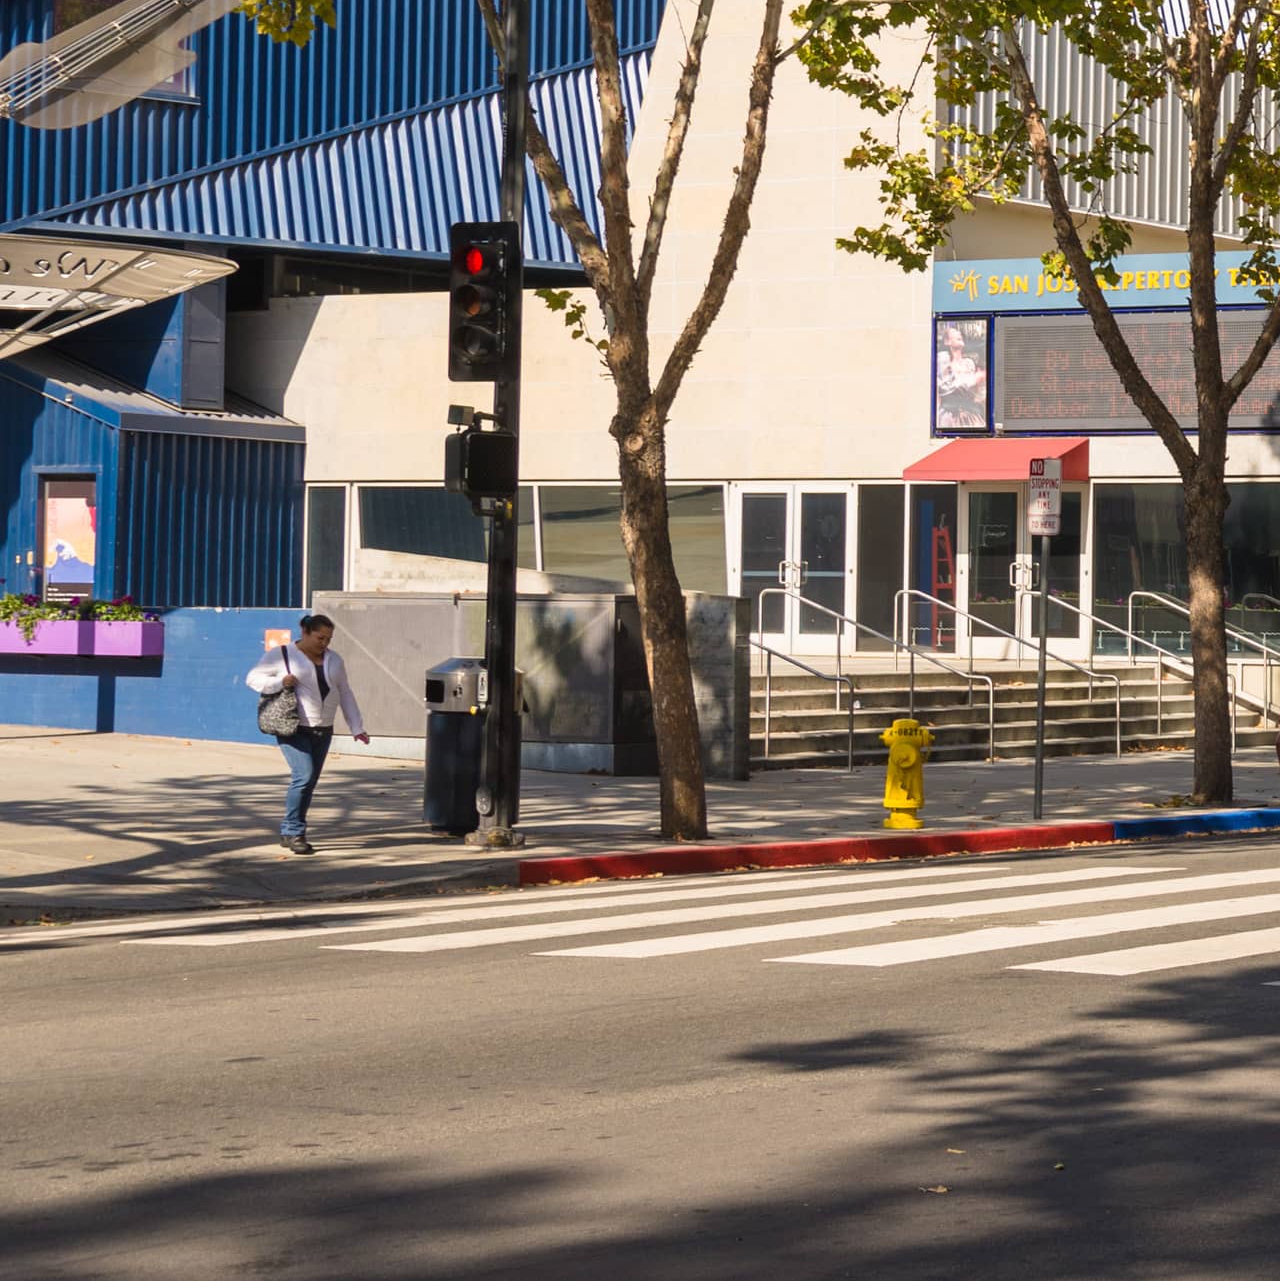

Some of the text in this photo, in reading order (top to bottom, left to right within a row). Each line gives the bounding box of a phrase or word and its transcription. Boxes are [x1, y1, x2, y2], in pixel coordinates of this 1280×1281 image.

[987, 275, 1030, 295] SAN
[1036, 272, 1081, 297] JOS
[1010, 397, 1089, 418] October
[1031, 460, 1043, 474] NO
[1031, 478, 1060, 489] STOPPING
[1037, 501, 1051, 509] TIME
